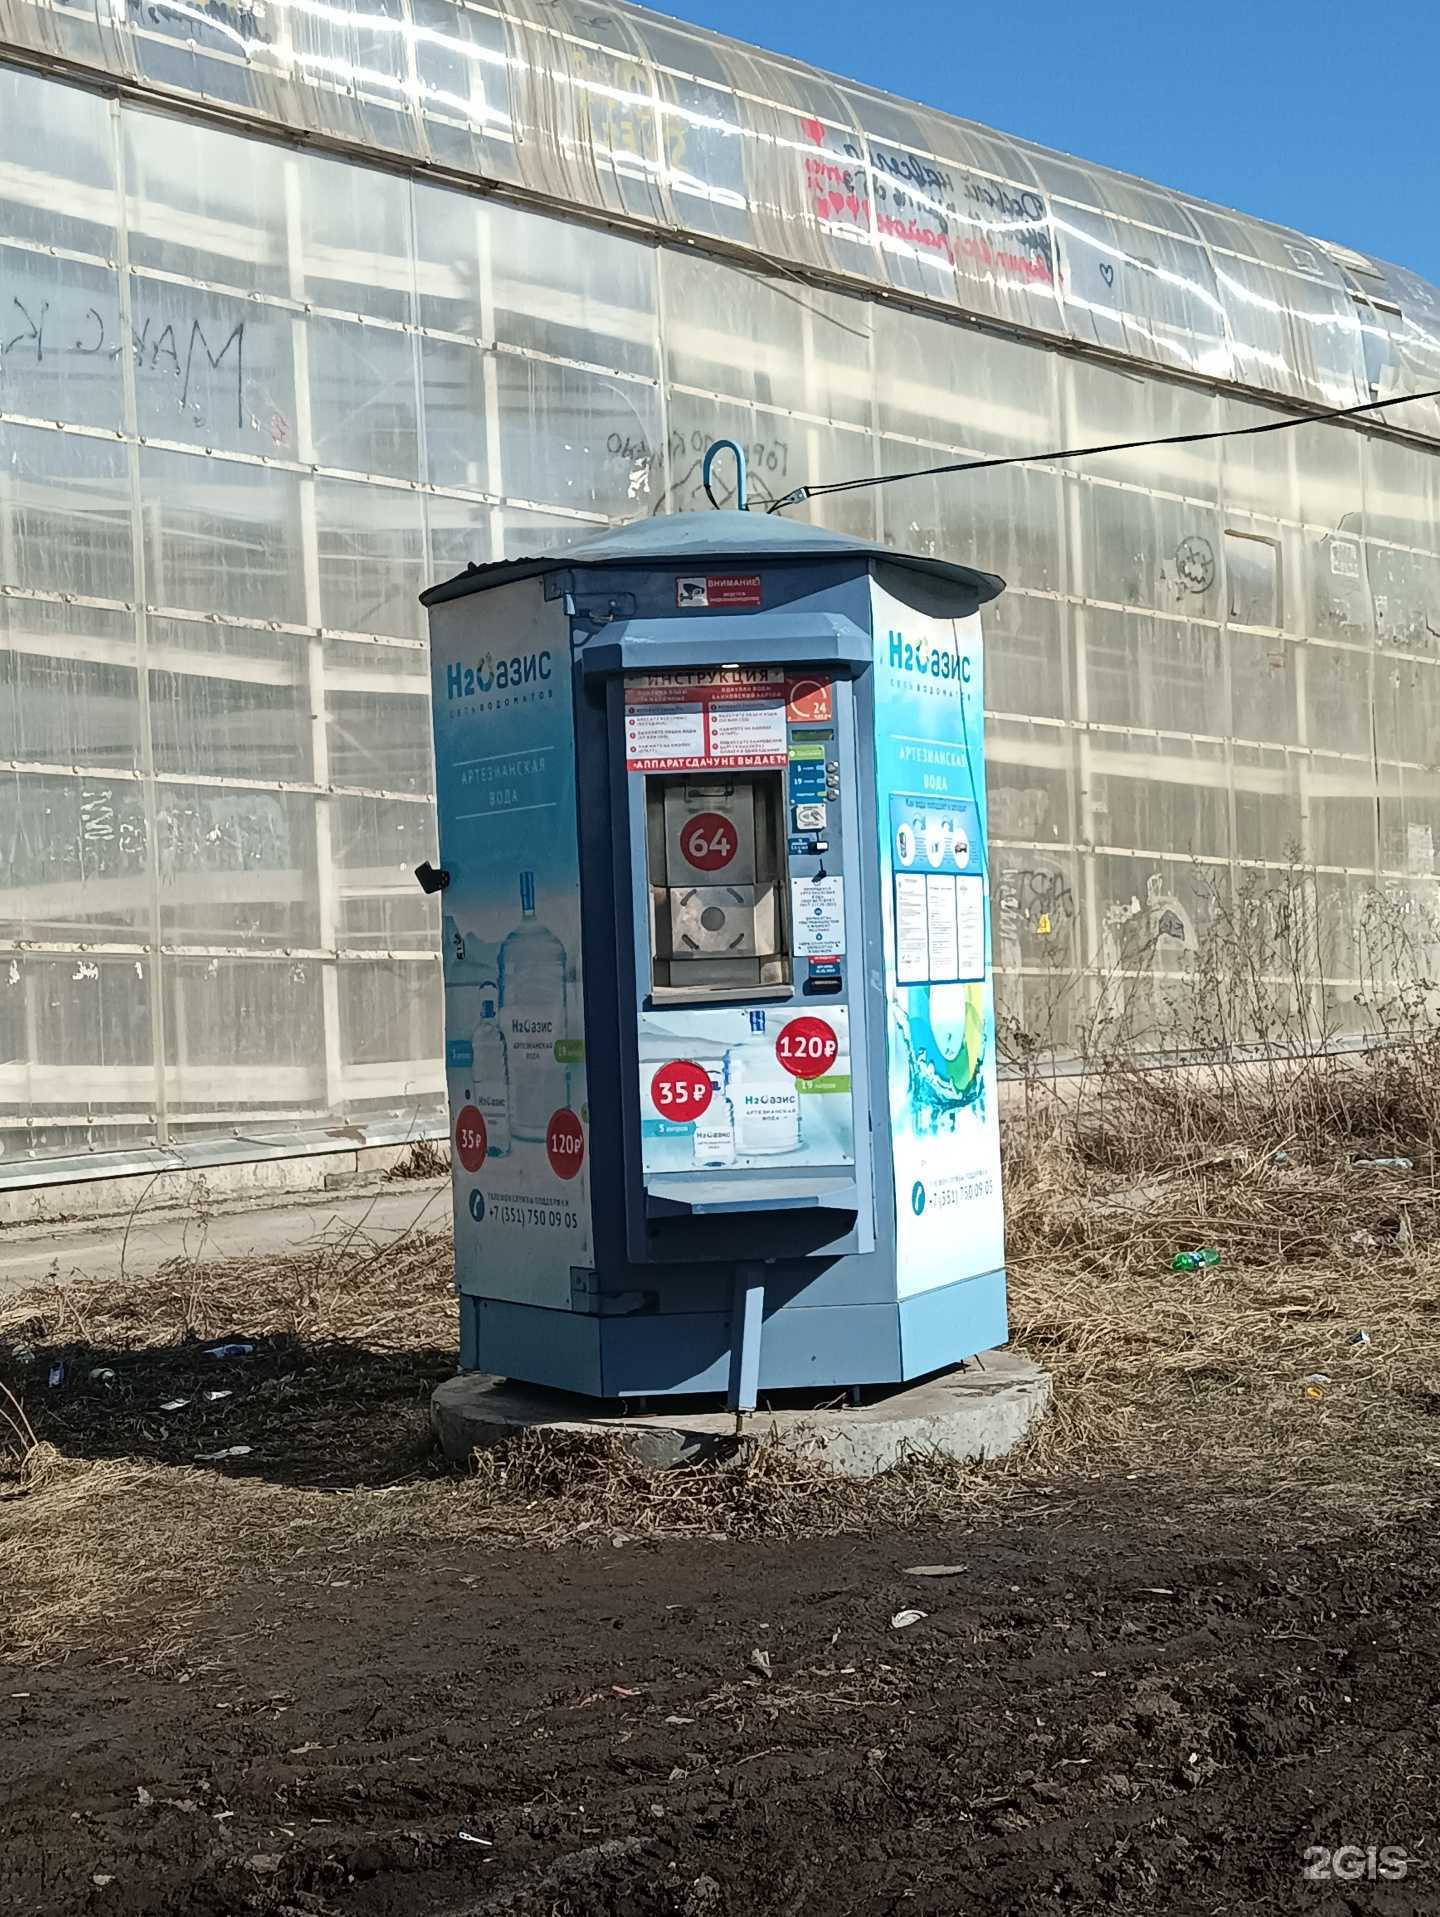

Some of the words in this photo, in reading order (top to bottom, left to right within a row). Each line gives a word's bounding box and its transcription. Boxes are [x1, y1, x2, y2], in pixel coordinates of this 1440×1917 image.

[648, 669, 769, 687] ИНСТРУКЦИЯ
[813, 702, 827, 713] 24
[461, 757, 545, 785] АРТЕЗИАНСКАЯ
[636, 759, 685, 769] АППАРАТ
[685, 757, 722, 768] СДАЧУ
[722, 756, 735, 766] НЕ
[923, 773, 948, 791] ВОДА
[488, 789, 520, 807] ВОДА
[689, 828, 731, 857] 64
[489, 1205, 499, 1220] +7
[501, 1206, 525, 1228] (351)
[528, 1208, 546, 1226] 750
[549, 1210, 562, 1227] 09
[565, 1212, 578, 1229] 05
